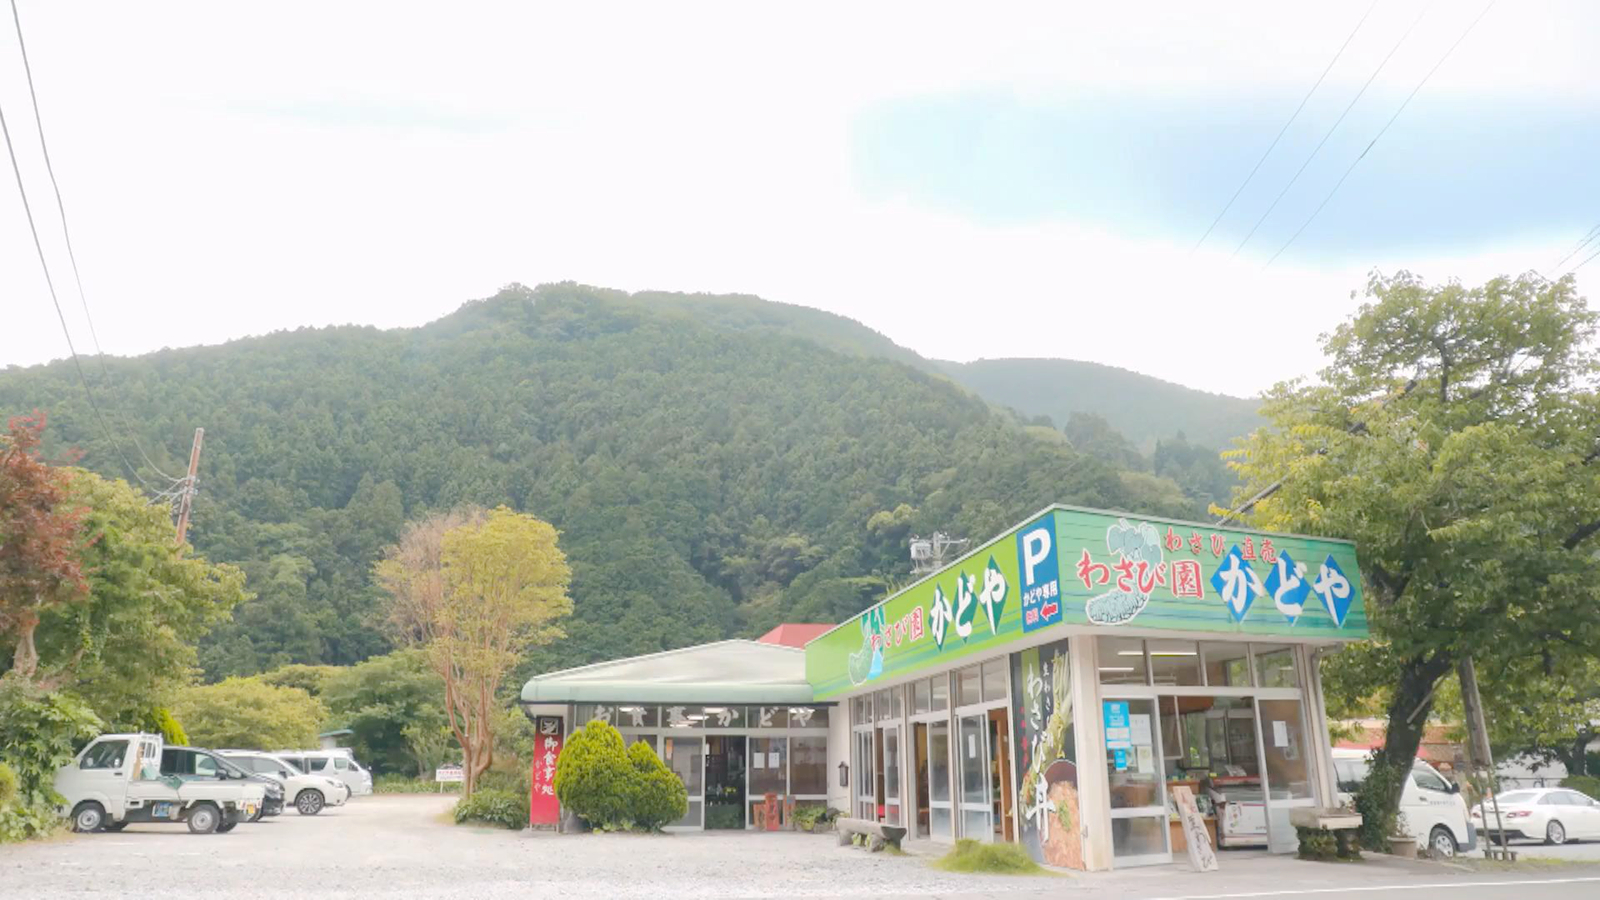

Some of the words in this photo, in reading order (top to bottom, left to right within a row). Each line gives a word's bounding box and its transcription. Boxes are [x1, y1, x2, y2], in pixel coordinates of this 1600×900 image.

[1022, 528, 1051, 586] P
[1242, 536, 1278, 563] 直売
[871, 606, 925, 653] わさび園
[929, 567, 1006, 646] かどや
[1023, 580, 1058, 607] かどや専用
[1076, 548, 1205, 600] わさび園
[1219, 553, 1351, 628] かどや
[541, 736, 559, 796] 御食事処
[1025, 663, 1057, 842] わさび丼
